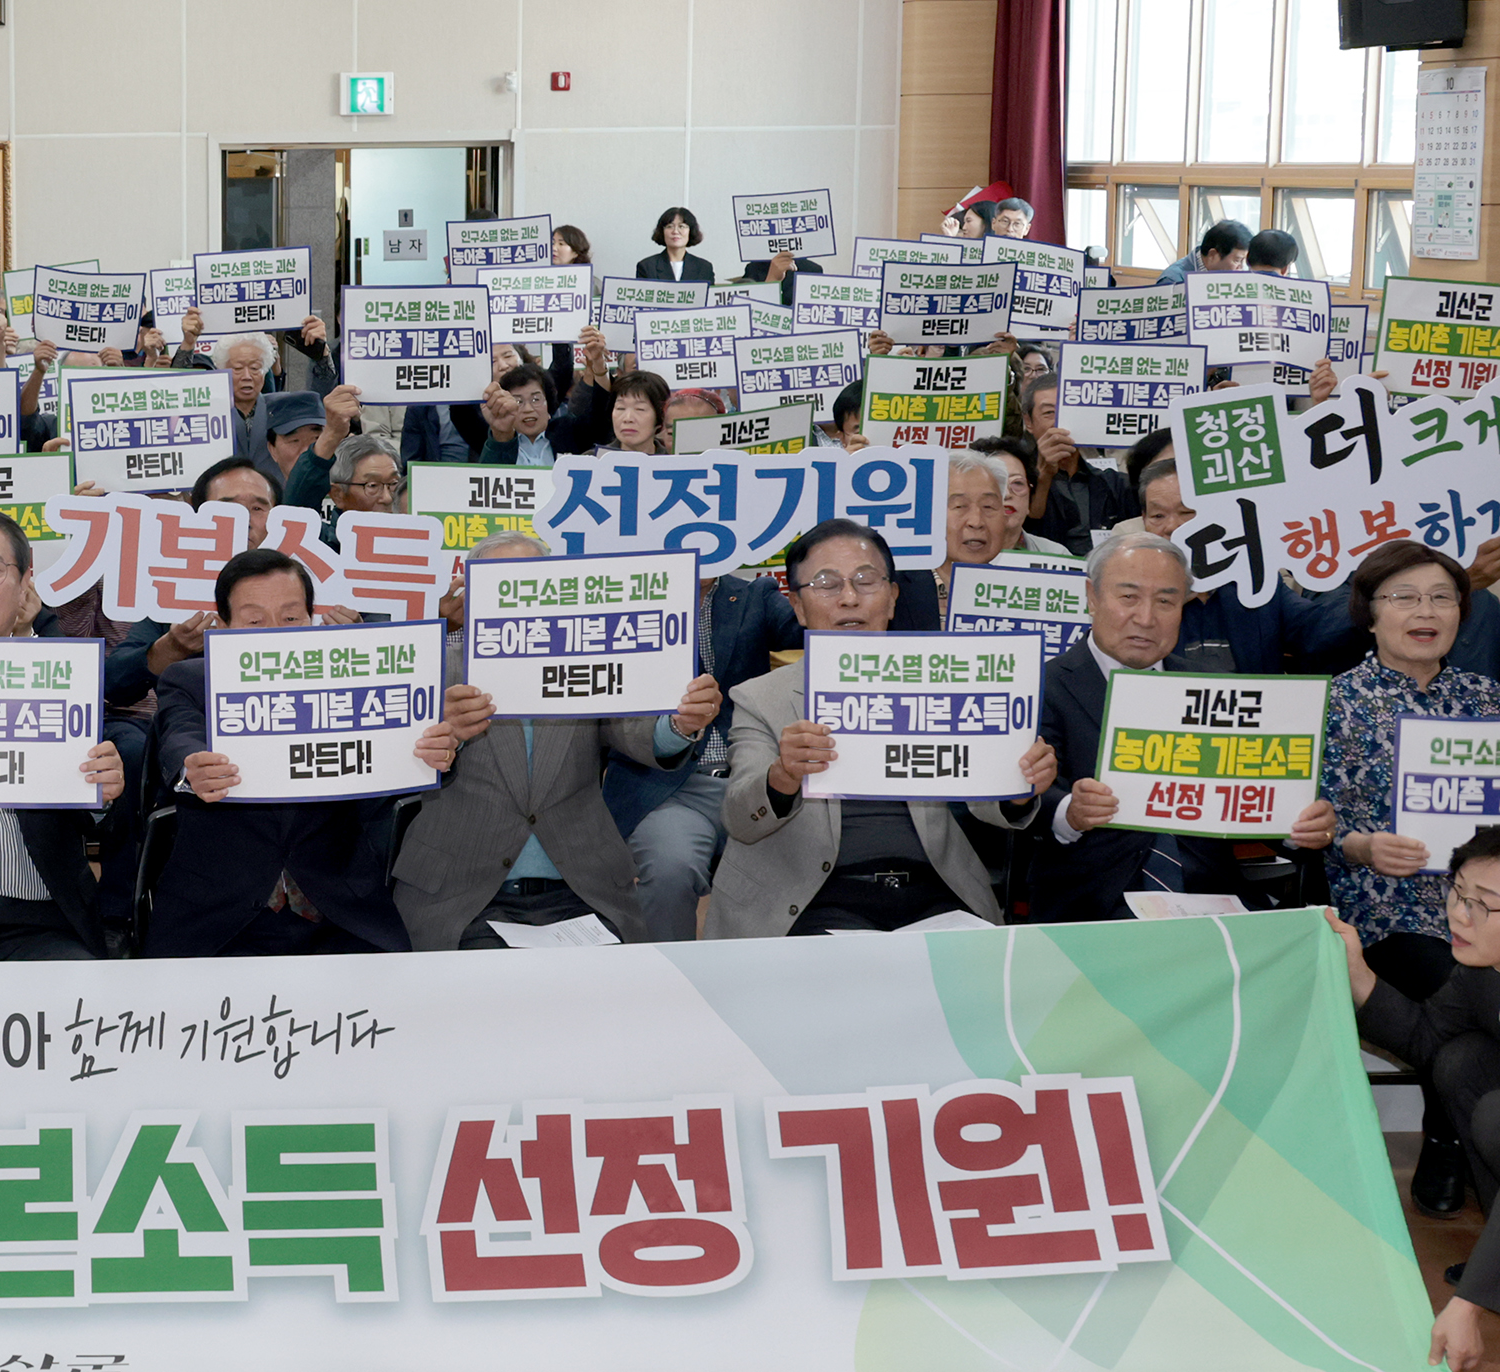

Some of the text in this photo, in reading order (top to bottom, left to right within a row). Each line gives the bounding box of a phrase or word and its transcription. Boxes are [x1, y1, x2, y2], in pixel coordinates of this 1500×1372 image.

[1446, 77, 1454, 90] 10
[1436, 142, 1441, 150] 20
[1444, 142, 1450, 150] 21
[1453, 142, 1459, 150] 22
[1461, 142, 1467, 150] 23
[1454, 126, 1459, 134] 15
[1462, 126, 1468, 134] 16
[1418, 158, 1423, 166] 25
[1426, 158, 1432, 166] 26
[1435, 158, 1441, 166] 27
[1443, 158, 1449, 166] 28
[1452, 158, 1458, 166] 29
[1461, 158, 1466, 166] 30
[746, 199, 817, 215] 인구소멸 없는 괴산
[740, 215, 828, 235] 농어촌 기본 소득이
[768, 238, 802, 253] 만든다!
[210, 258, 296, 278] 인구소멸 없는 괴산
[900, 273, 999, 289] 인구소멸 없는 괴산
[201, 278, 306, 302] 농어촌 기본 소득이
[887, 293, 1008, 313] 농어촌 기본 소득이
[235, 304, 274, 323] 만든다!
[922, 319, 968, 336] 만든다!
[1195, 404, 1266, 448] 청정
[1304, 387, 1382, 485] 더
[1201, 442, 1274, 485] 괴산
[50, 505, 436, 620] 기본소득
[1185, 497, 1265, 596] 더
[499, 572, 668, 608] 인구소멸 없는 괴산
[477, 612, 687, 656] 농어촌 기본 소득이
[32, 661, 72, 689] 괴산
[240, 644, 415, 682] 인구소멸 없는 괴산
[542, 663, 622, 698] 만든다!
[840, 654, 1015, 682] 인구소멸 없는 괴산
[14, 703, 91, 738] 소득이
[219, 686, 434, 733] 농어촌 기본 소득이
[818, 695, 1032, 731] 농어촌 기본 소득이
[1182, 689, 1262, 727] 괴산군
[290, 740, 372, 779] 만든다!
[886, 744, 968, 778] 만든다!
[1114, 732, 1311, 776] 농어촌 기본소득
[1146, 782, 1274, 823] 선정 기원!
[64, 997, 166, 1082] 함께
[180, 994, 396, 1080] 기원합니다
[437, 1108, 741, 1292] 선정
[779, 1089, 1154, 1270] 기원!
